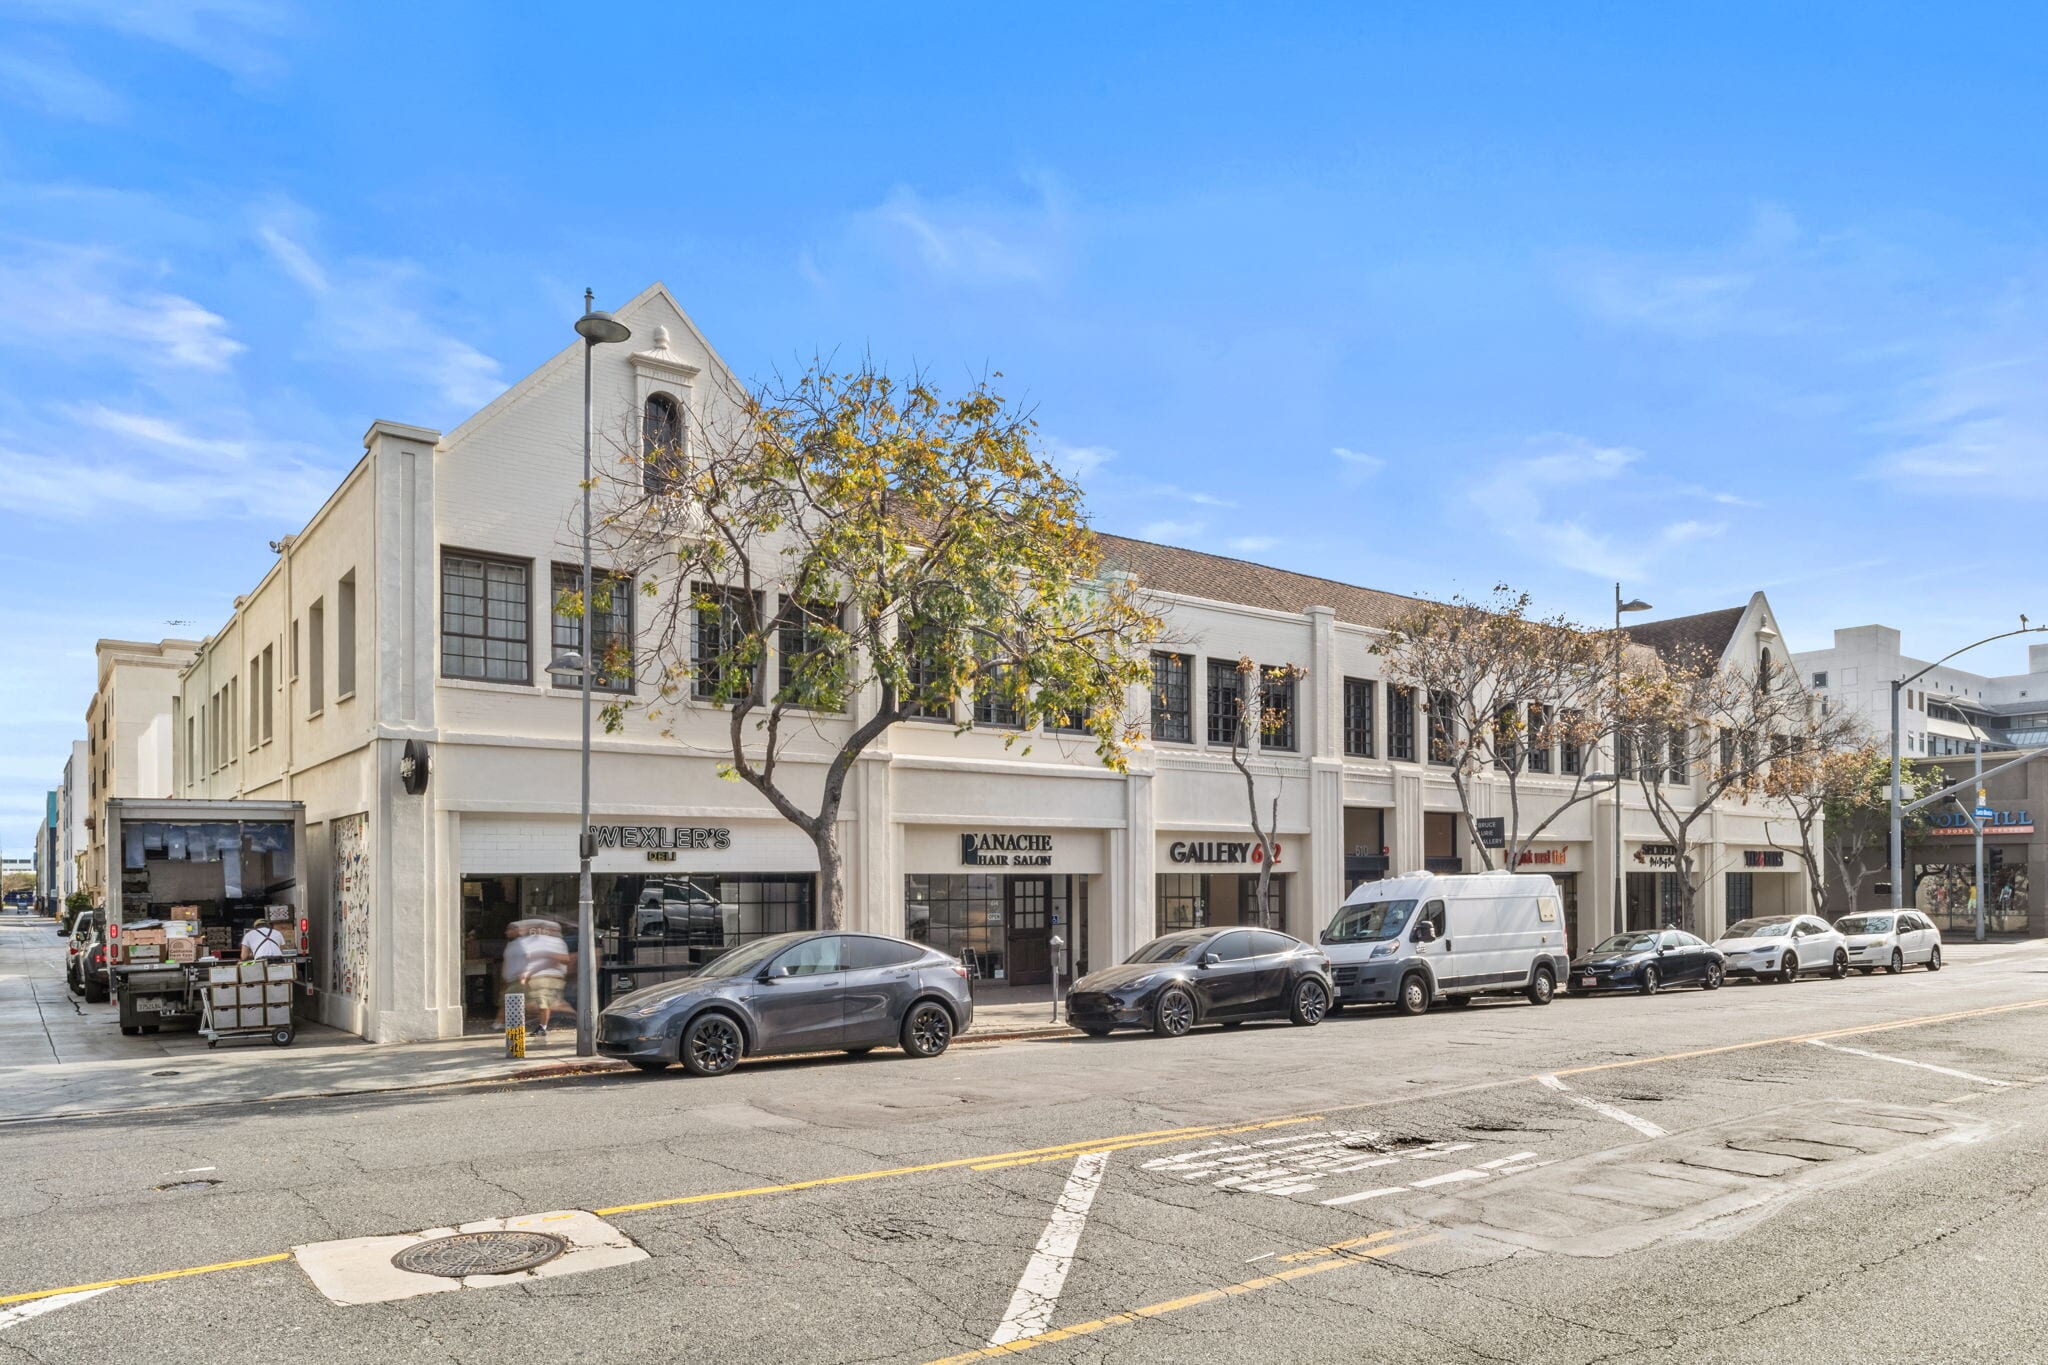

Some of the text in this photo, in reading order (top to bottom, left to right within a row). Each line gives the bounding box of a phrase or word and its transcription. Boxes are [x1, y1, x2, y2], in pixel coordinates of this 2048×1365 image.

[590, 826, 730, 849] WEXLER'S
[647, 852, 676, 861] DELI
[961, 833, 1053, 865] PANACHE
[978, 855, 1052, 865] HAIR SALON
[1169, 841, 1282, 863] GALLERY 62
